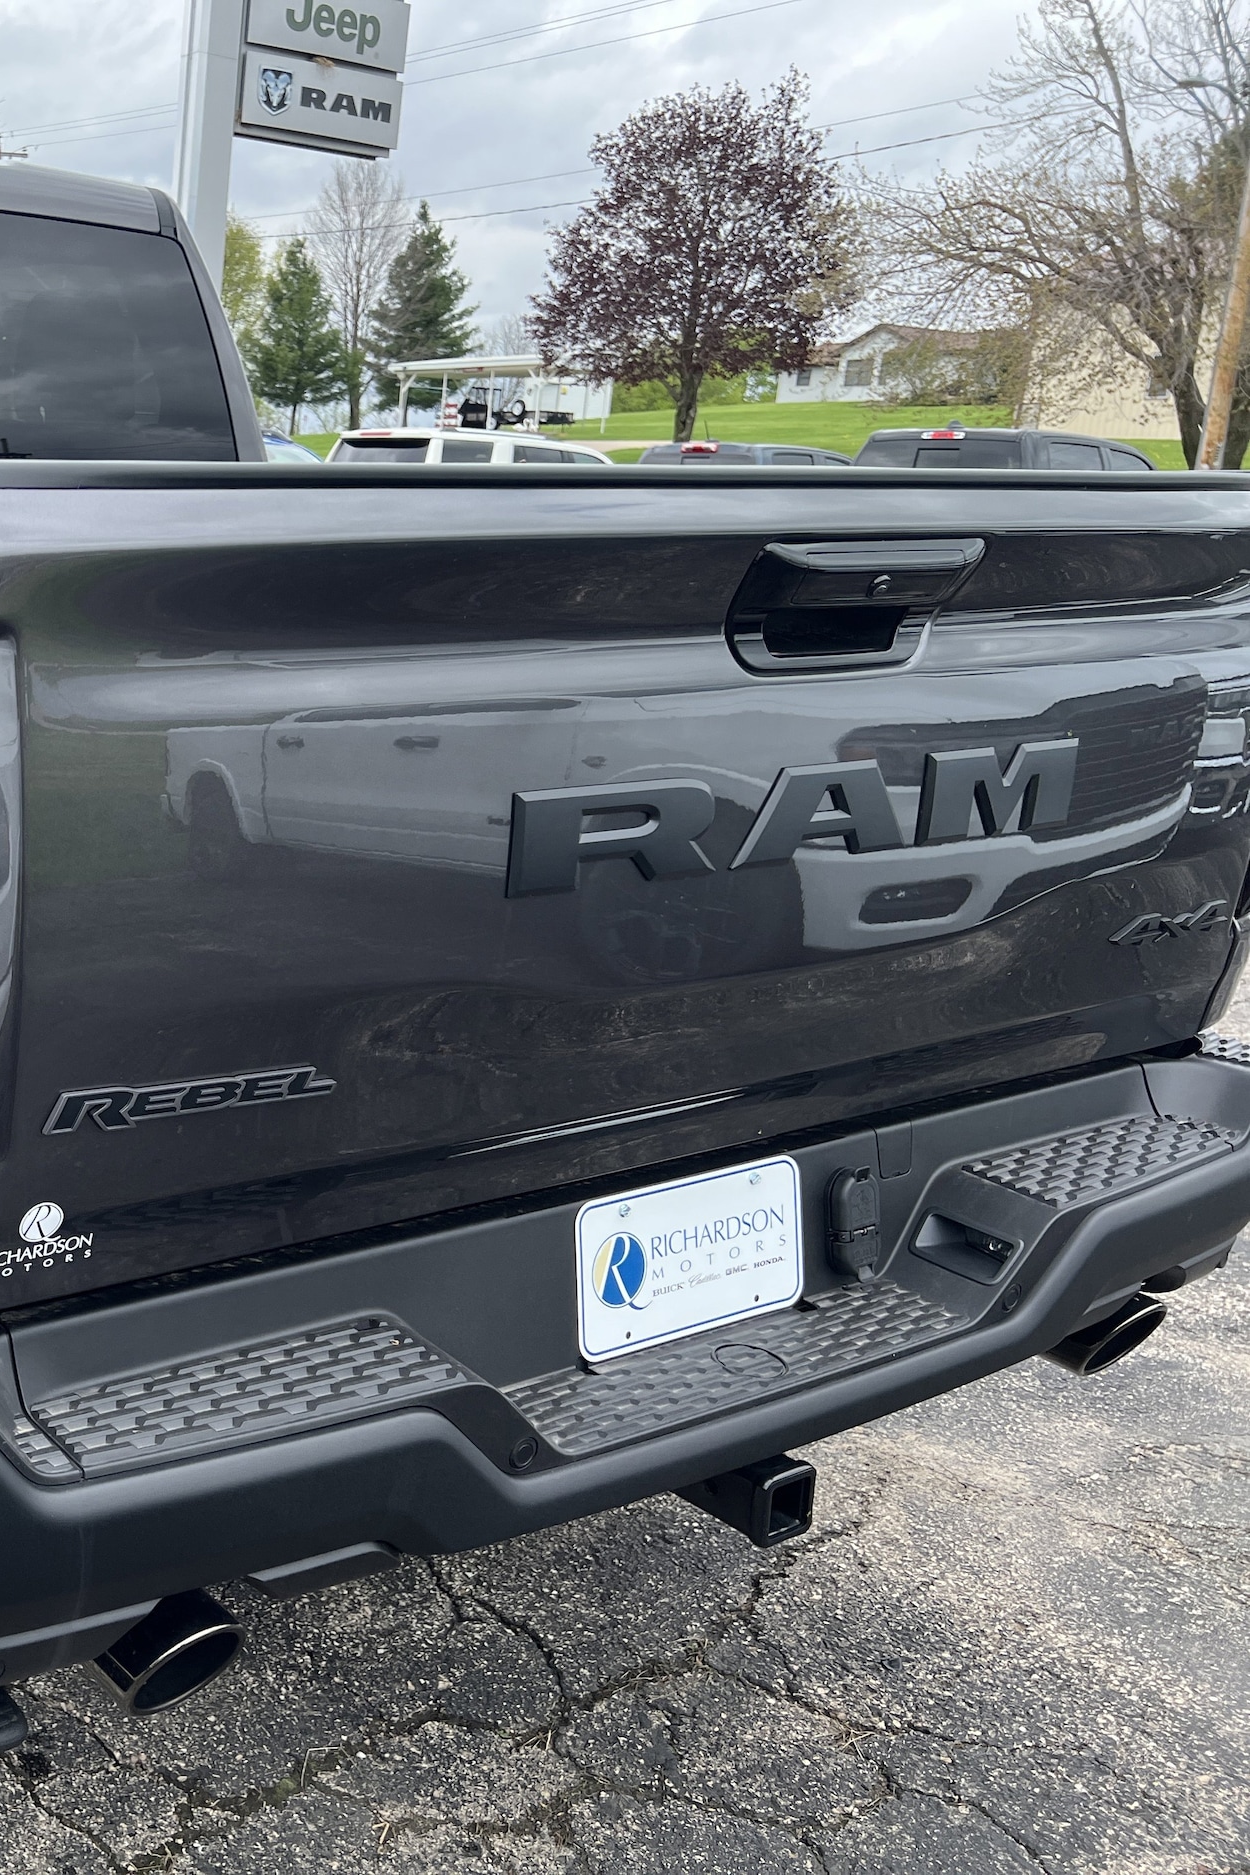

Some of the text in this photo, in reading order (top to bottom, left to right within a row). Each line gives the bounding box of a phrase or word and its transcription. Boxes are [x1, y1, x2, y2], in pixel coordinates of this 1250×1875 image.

[286, 0, 381, 54] Jeep
[301, 86, 392, 123] RAM
[504, 737, 1080, 899] RAM
[41, 1064, 337, 1135] REBEL
[651, 1204, 785, 1260] RICHARDSON
[651, 1234, 787, 1281] MOTORS
[652, 1282, 686, 1298] BUICK
[725, 1263, 749, 1277] GMC
[753, 1256, 784, 1269] HONDA
